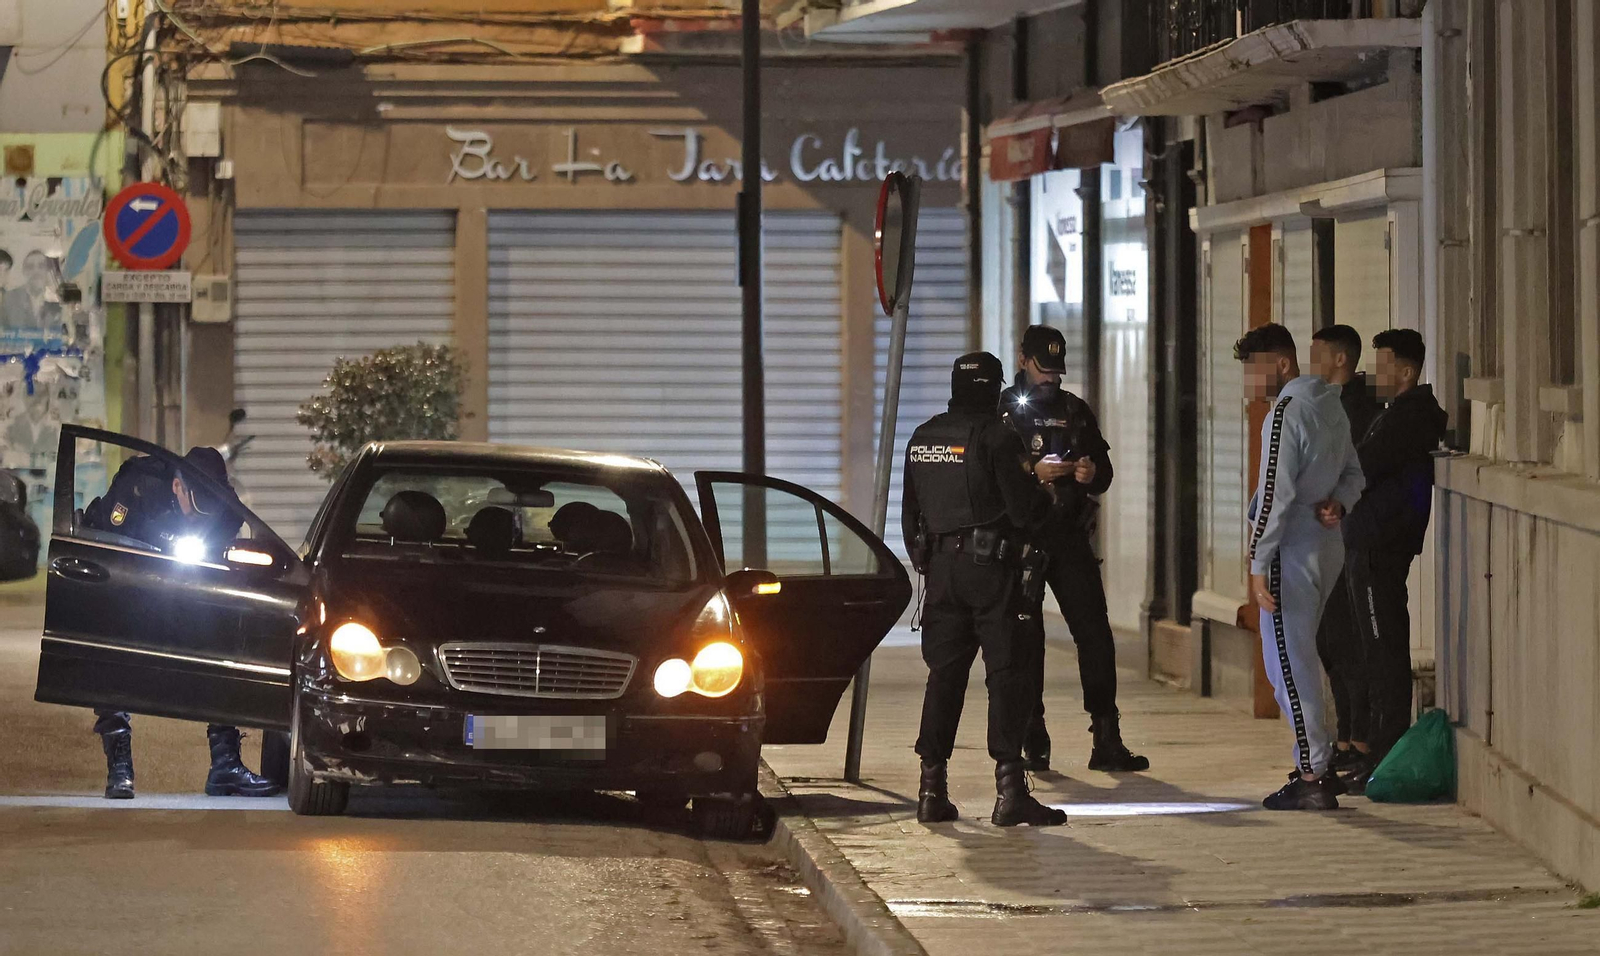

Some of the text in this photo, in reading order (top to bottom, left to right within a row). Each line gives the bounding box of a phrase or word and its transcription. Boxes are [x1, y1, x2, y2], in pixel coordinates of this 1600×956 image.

[446, 125, 537, 184] Bar
[123, 273, 171, 282] EXCEPTO
[910, 445, 952, 454] POLICIA
[910, 454, 964, 463] NACIONAL
